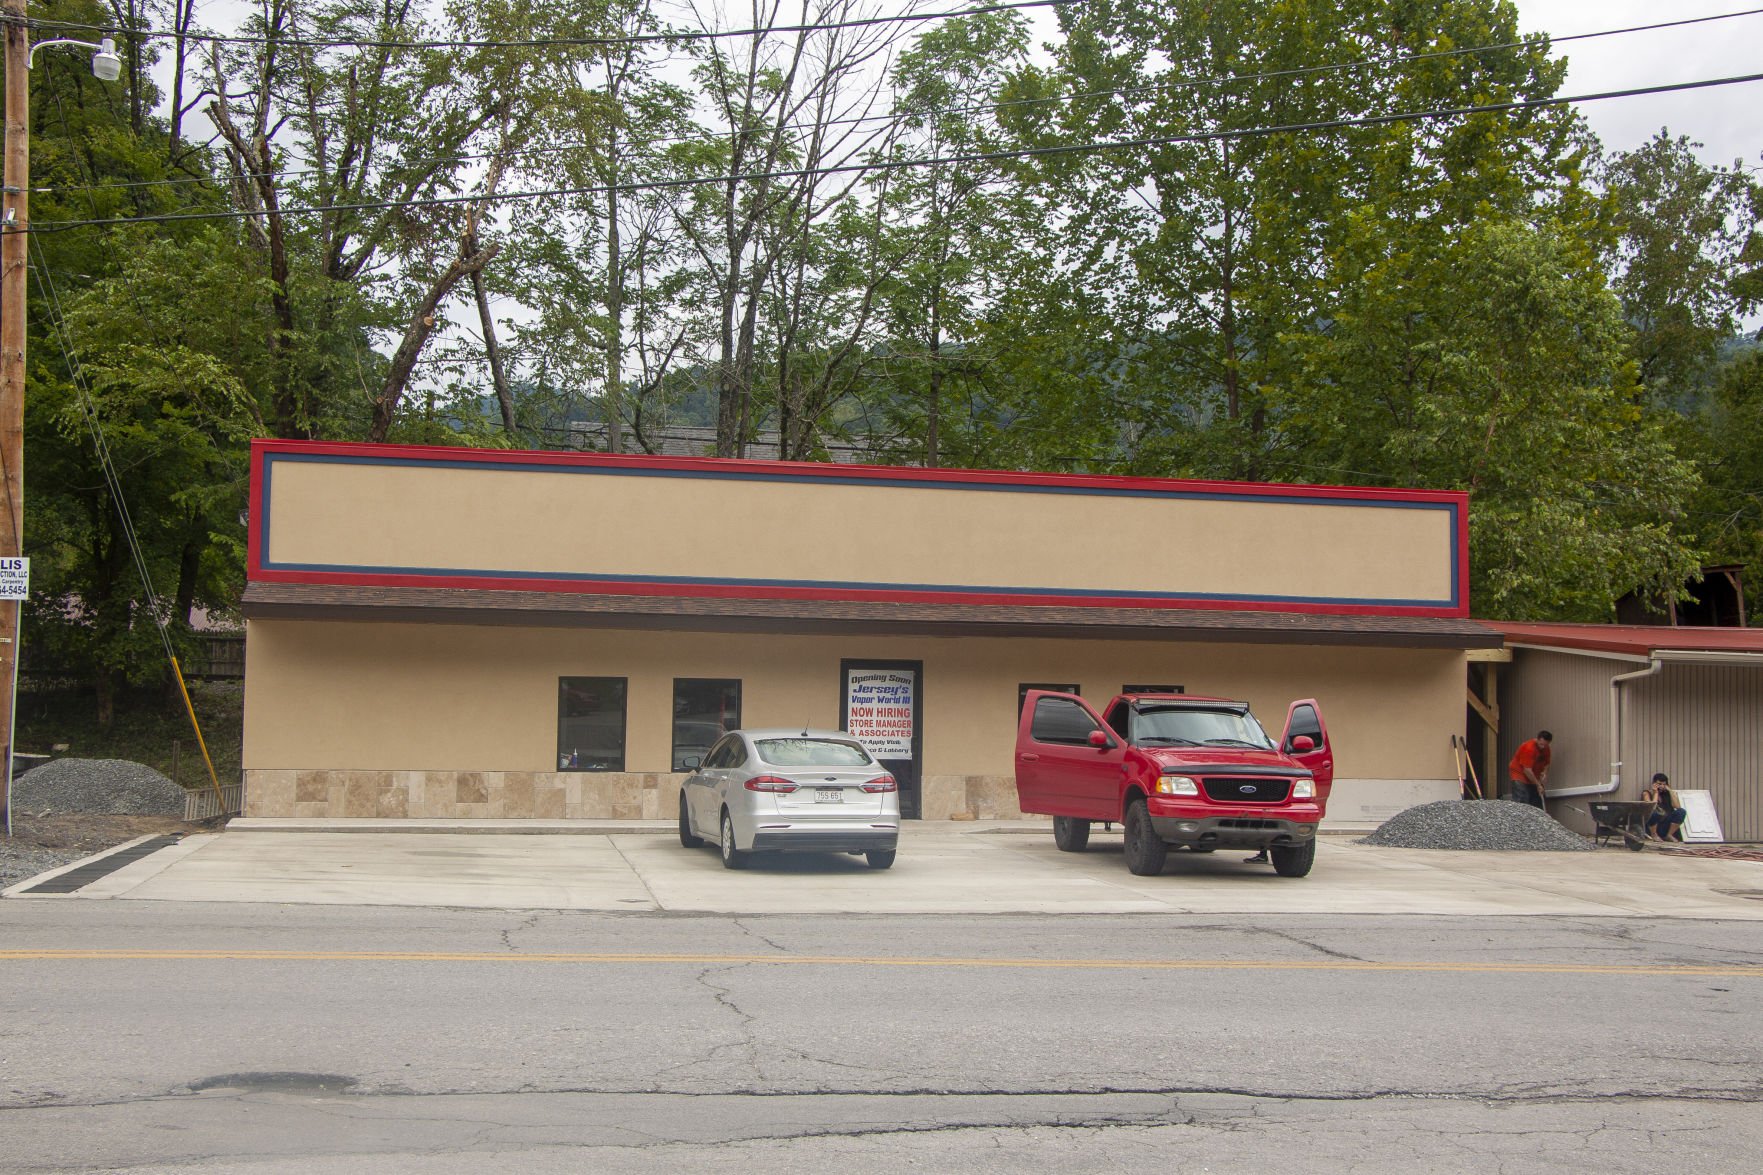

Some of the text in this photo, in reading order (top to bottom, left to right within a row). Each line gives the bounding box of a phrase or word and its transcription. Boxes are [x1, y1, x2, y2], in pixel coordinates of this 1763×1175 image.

[851, 673, 912, 685] Opening Soon
[853, 684, 909, 696] Jersey's
[851, 695, 875, 705] Vapor
[877, 695, 901, 704] World
[851, 707, 911, 718] NOW HIRING
[849, 719, 912, 729] STORE MANAGER
